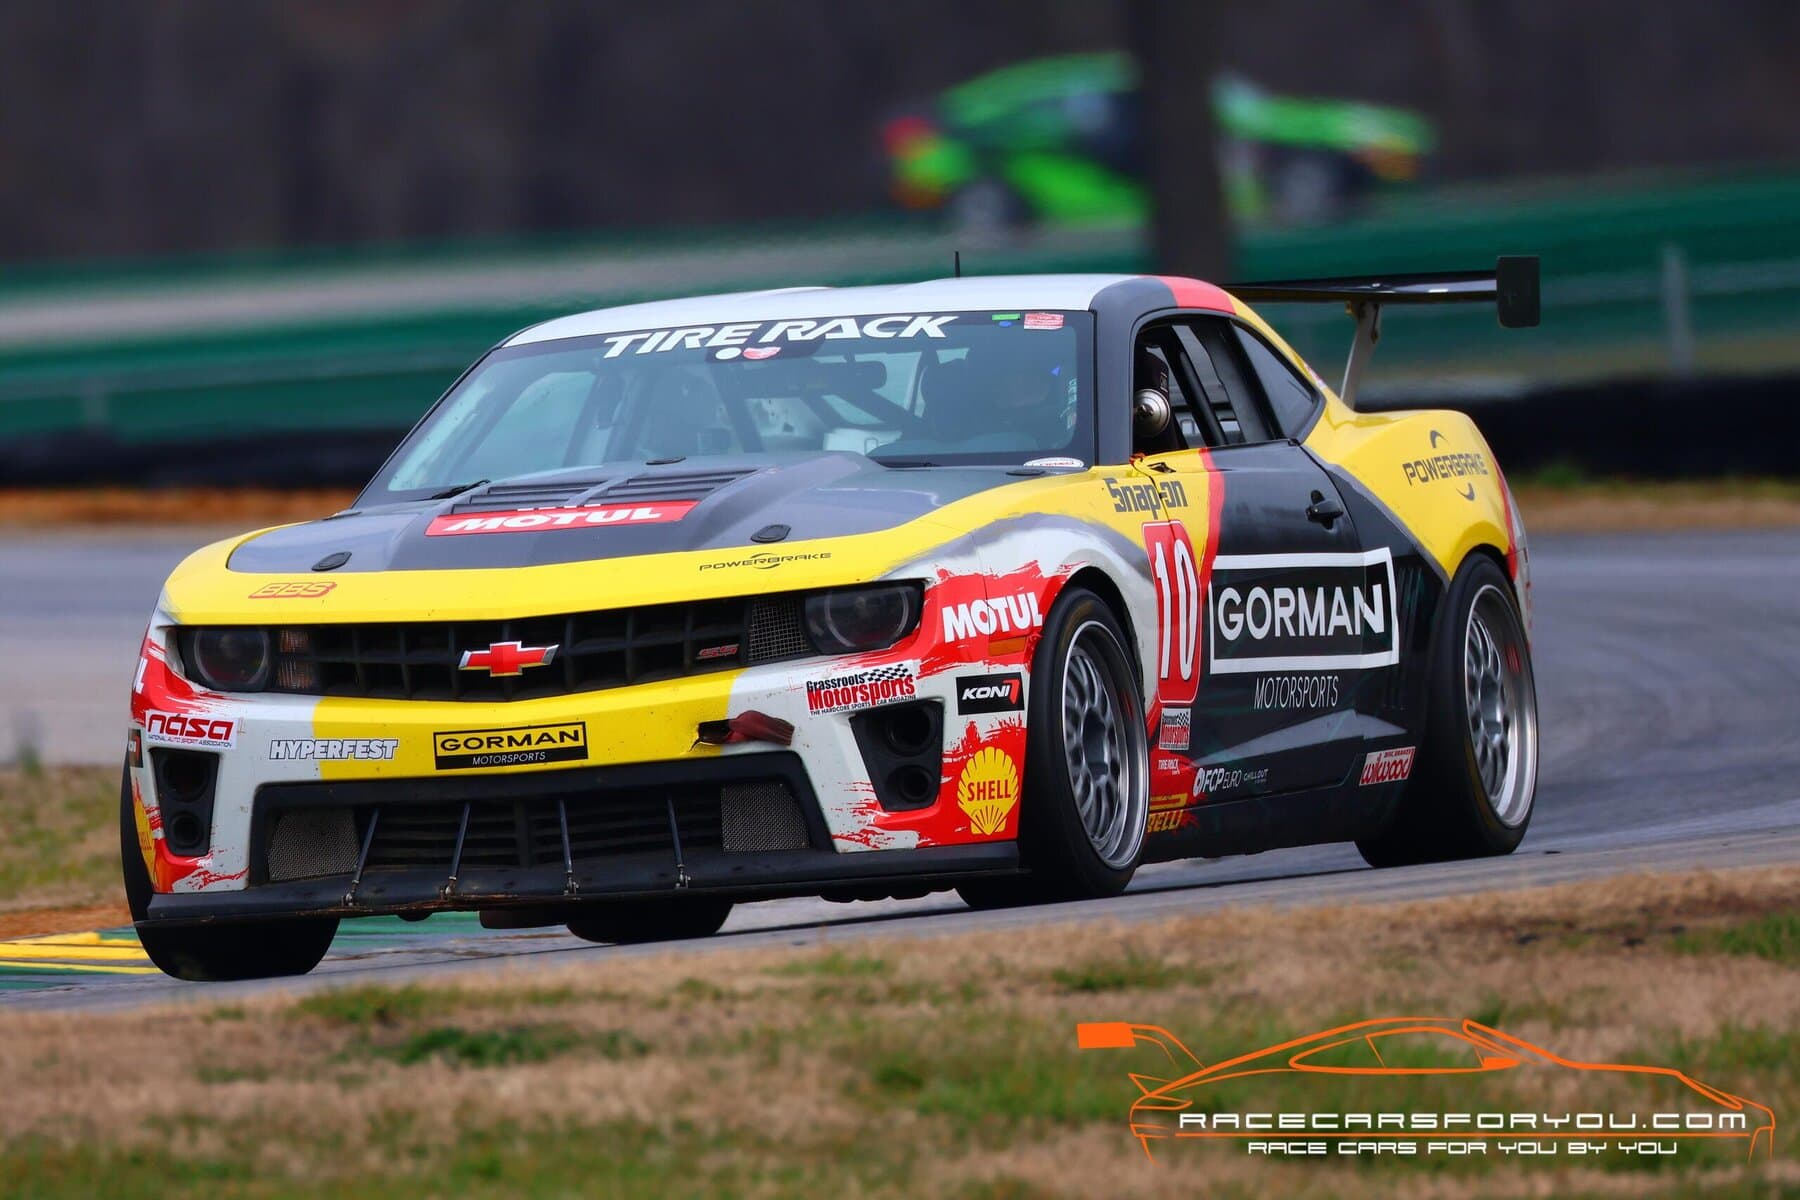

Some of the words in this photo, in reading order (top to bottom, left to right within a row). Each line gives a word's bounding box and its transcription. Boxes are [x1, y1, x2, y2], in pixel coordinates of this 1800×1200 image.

[603, 323, 762, 358] TIRE
[760, 315, 960, 343] RACK
[1402, 453, 1488, 487] POWERBRAKE
[1103, 477, 1188, 520] Snap-on
[443, 507, 663, 532] MOTUL
[699, 552, 832, 571] POWERBRAKE
[248, 581, 338, 599] BBS
[942, 591, 1043, 643] MOTUL
[1154, 538, 1198, 681] 10
[1218, 583, 1385, 641] GORMAN
[806, 672, 866, 692] Grassroots
[807, 674, 916, 711] Motorsports
[962, 685, 1011, 700] KONI
[1254, 675, 1339, 710] MOTORSPORTS
[269, 739, 399, 760] HYPERFEST
[439, 729, 581, 752] GORMAN
[472, 751, 547, 767] MOTORSPORTS
[967, 779, 1012, 802] SHELL
[1203, 767, 1225, 793] FCP
[1147, 809, 1184, 832] RELLI
